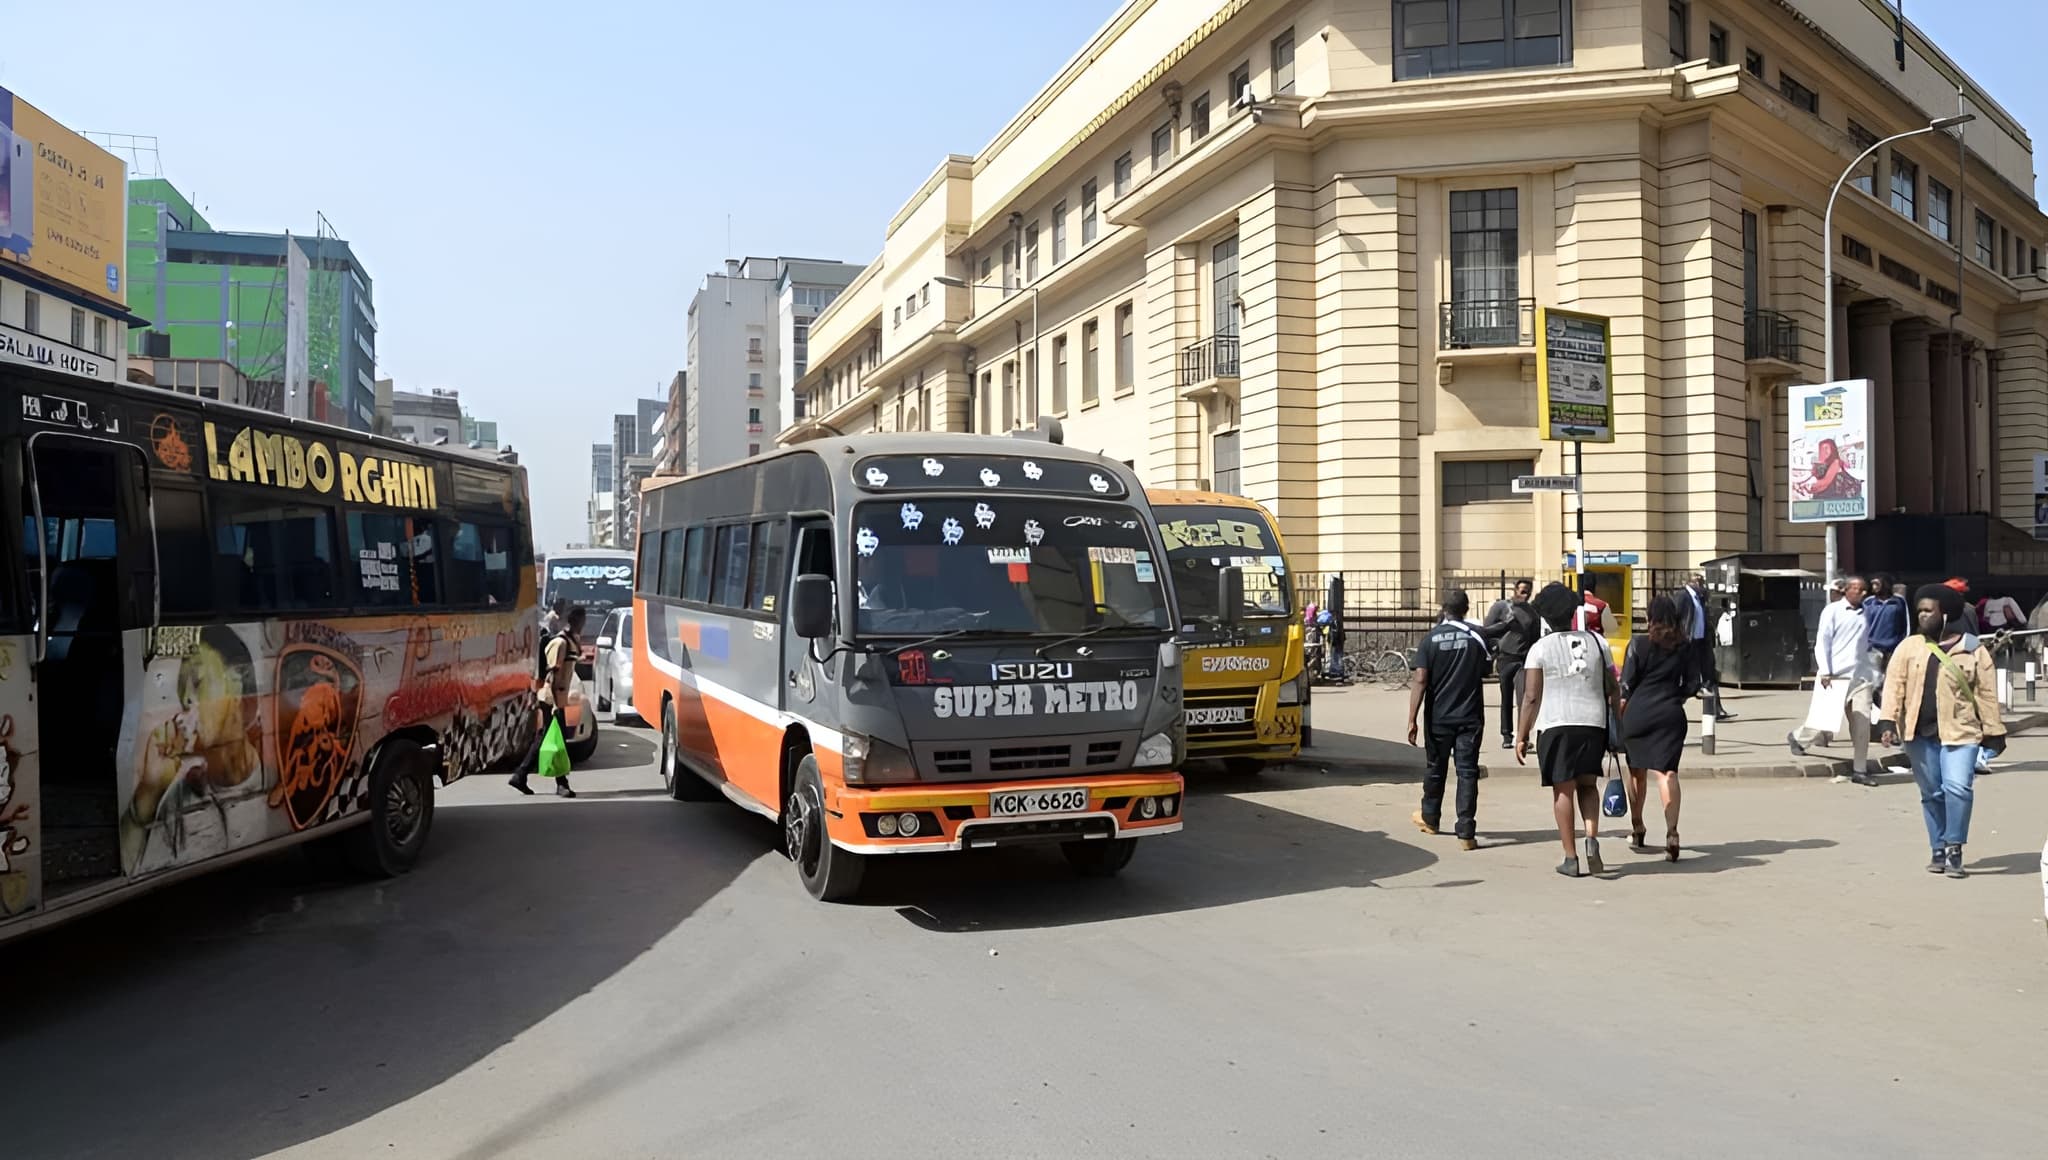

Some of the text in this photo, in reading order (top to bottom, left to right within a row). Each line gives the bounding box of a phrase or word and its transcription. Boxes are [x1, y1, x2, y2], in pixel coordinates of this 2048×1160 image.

[991, 663, 1073, 681] ISUZU
[934, 680, 1138, 718] SUPER METRO
[994, 791, 1085, 813] KCK 662G
